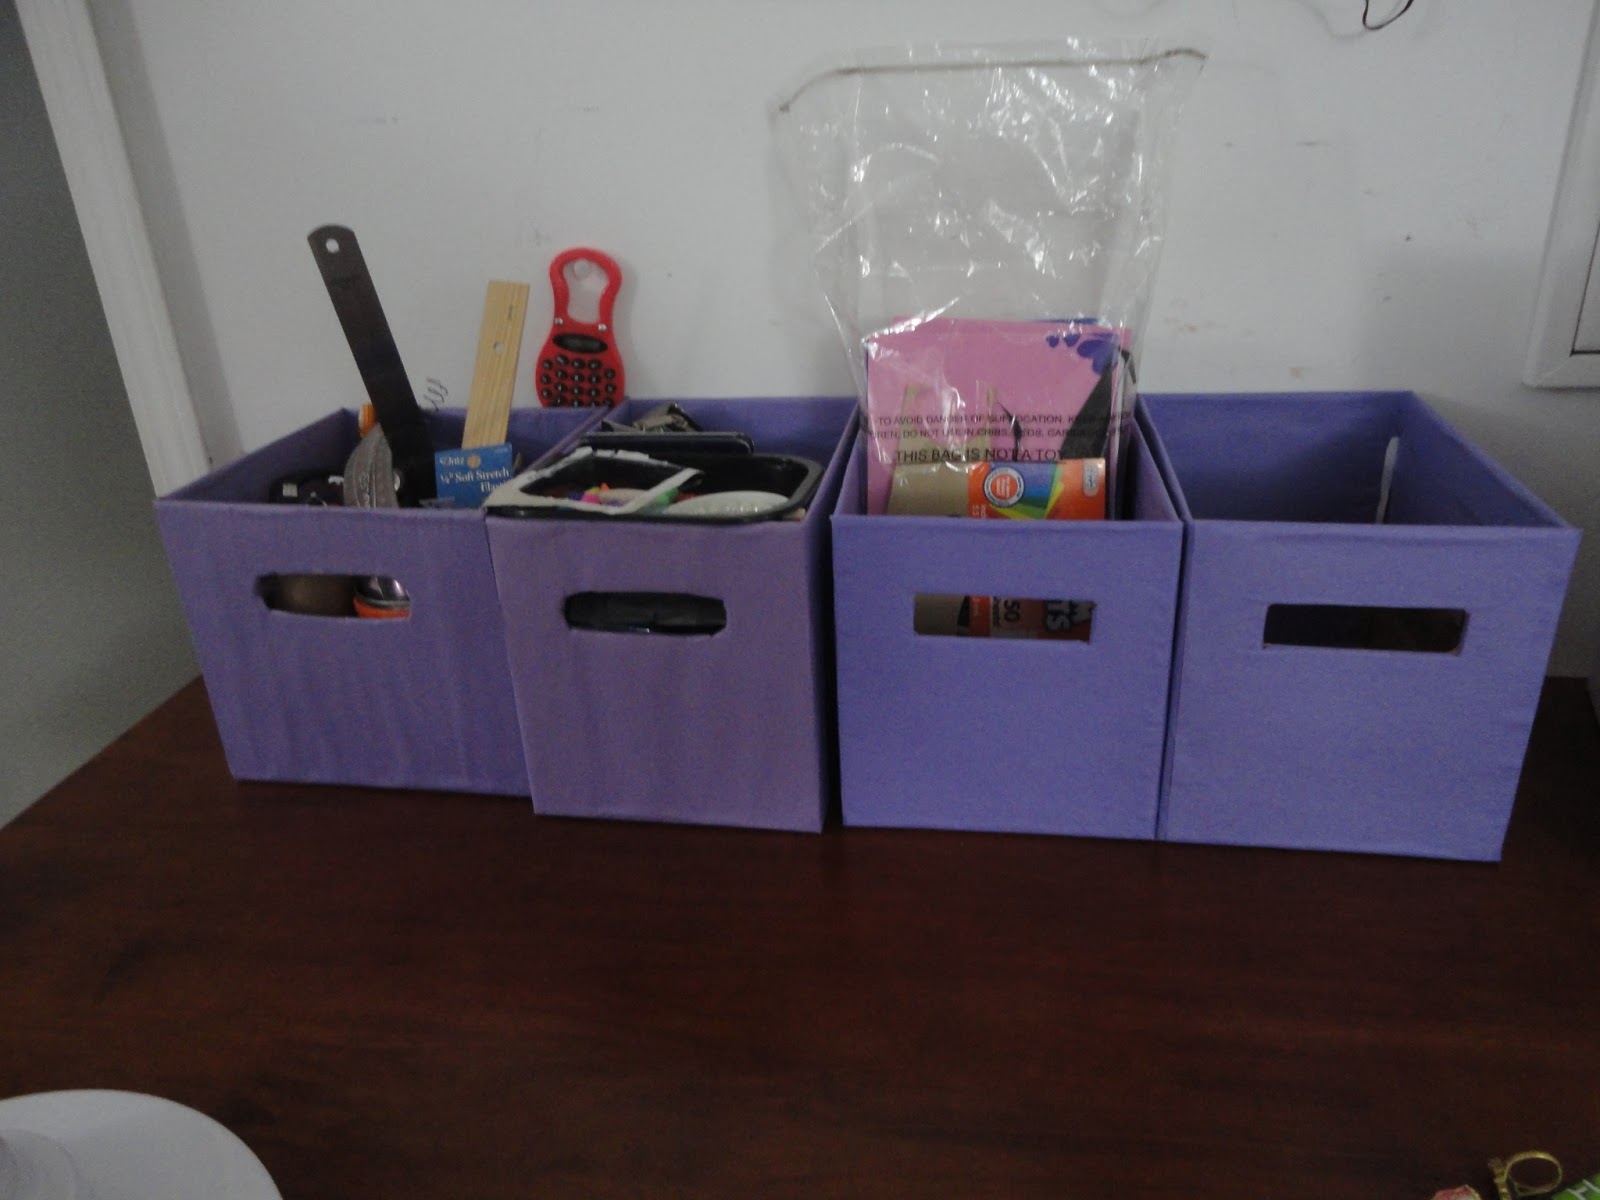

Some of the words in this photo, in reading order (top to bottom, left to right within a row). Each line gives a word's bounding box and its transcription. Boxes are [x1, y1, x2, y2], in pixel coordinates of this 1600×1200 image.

[878, 416, 892, 426] TO
[893, 415, 923, 425] AVOID
[903, 428, 918, 439] DO
[920, 428, 939, 438] NOT
[896, 448, 928, 463] THIS
[931, 447, 962, 462] BAG
[966, 447, 980, 461] IS
[985, 447, 1019, 462] NOT
[1021, 448, 1032, 462] A
[1034, 448, 1064, 462] TOY
[455, 469, 474, 483] Soft
[475, 466, 510, 480] Stretch
[1003, 599, 1021, 623] 50
